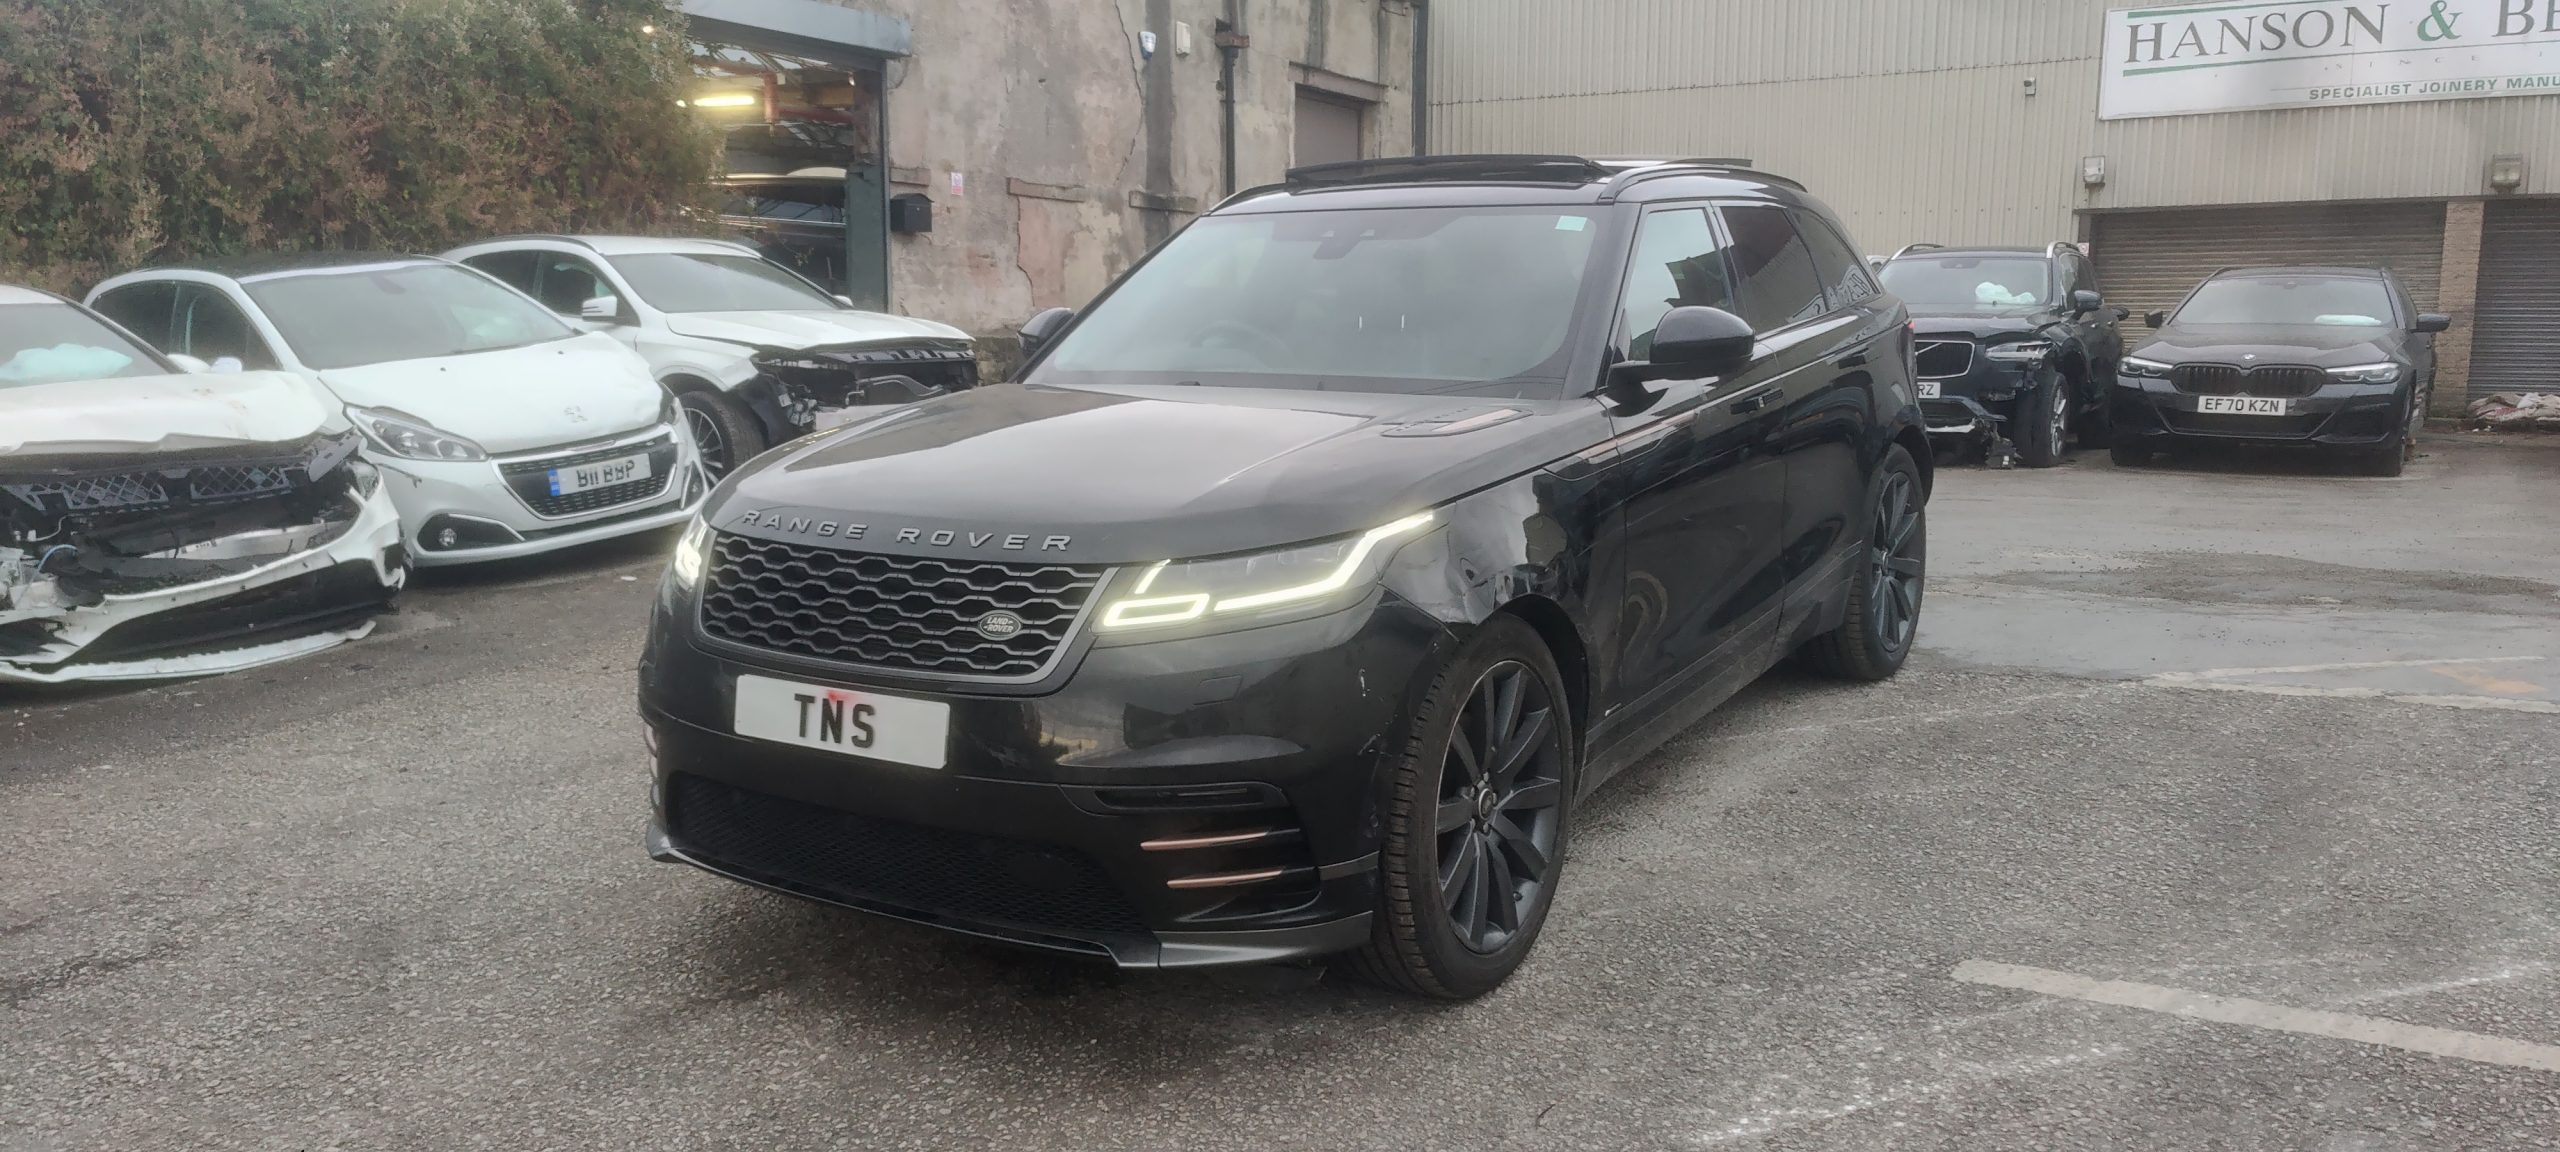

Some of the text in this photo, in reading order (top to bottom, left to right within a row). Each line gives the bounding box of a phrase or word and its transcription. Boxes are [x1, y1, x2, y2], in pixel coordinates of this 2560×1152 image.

[2124, 4, 2391, 63] HANSON
[2416, 0, 2463, 41] &
[2309, 84, 2411, 100] SPECIALIST
[2419, 79, 2497, 94] JOINERY
[2205, 398, 2279, 412] EF70 KZN
[743, 510, 1071, 550] RANGE ROVER
[794, 693, 875, 748] TNS
